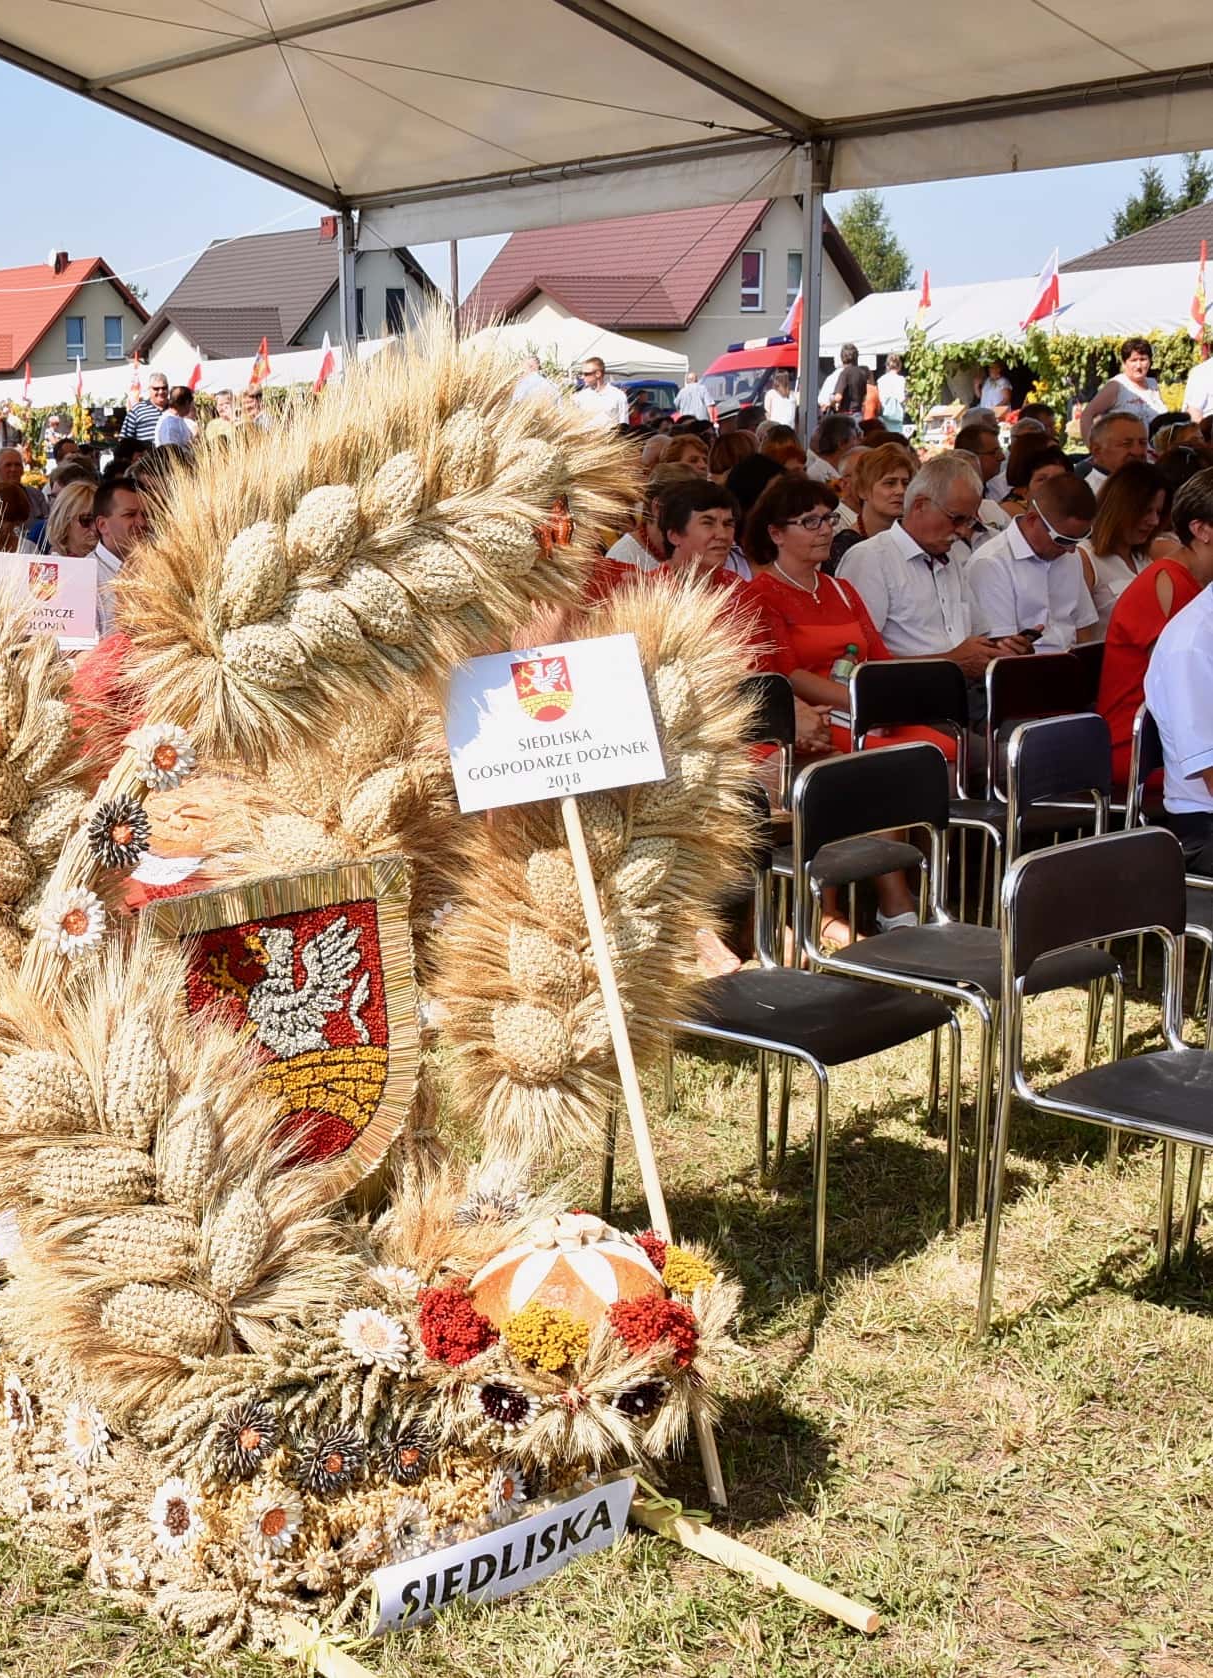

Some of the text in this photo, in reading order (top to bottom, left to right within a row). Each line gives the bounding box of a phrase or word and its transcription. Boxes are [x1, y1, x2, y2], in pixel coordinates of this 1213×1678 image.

[32, 607, 76, 619] TATYCZE
[517, 728, 593, 751] SIEDLISKA
[468, 738, 650, 782] GOSPODARZE DOŻYNEK
[546, 772, 582, 789] 2018
[398, 1500, 612, 1619] SIEDLISKA
